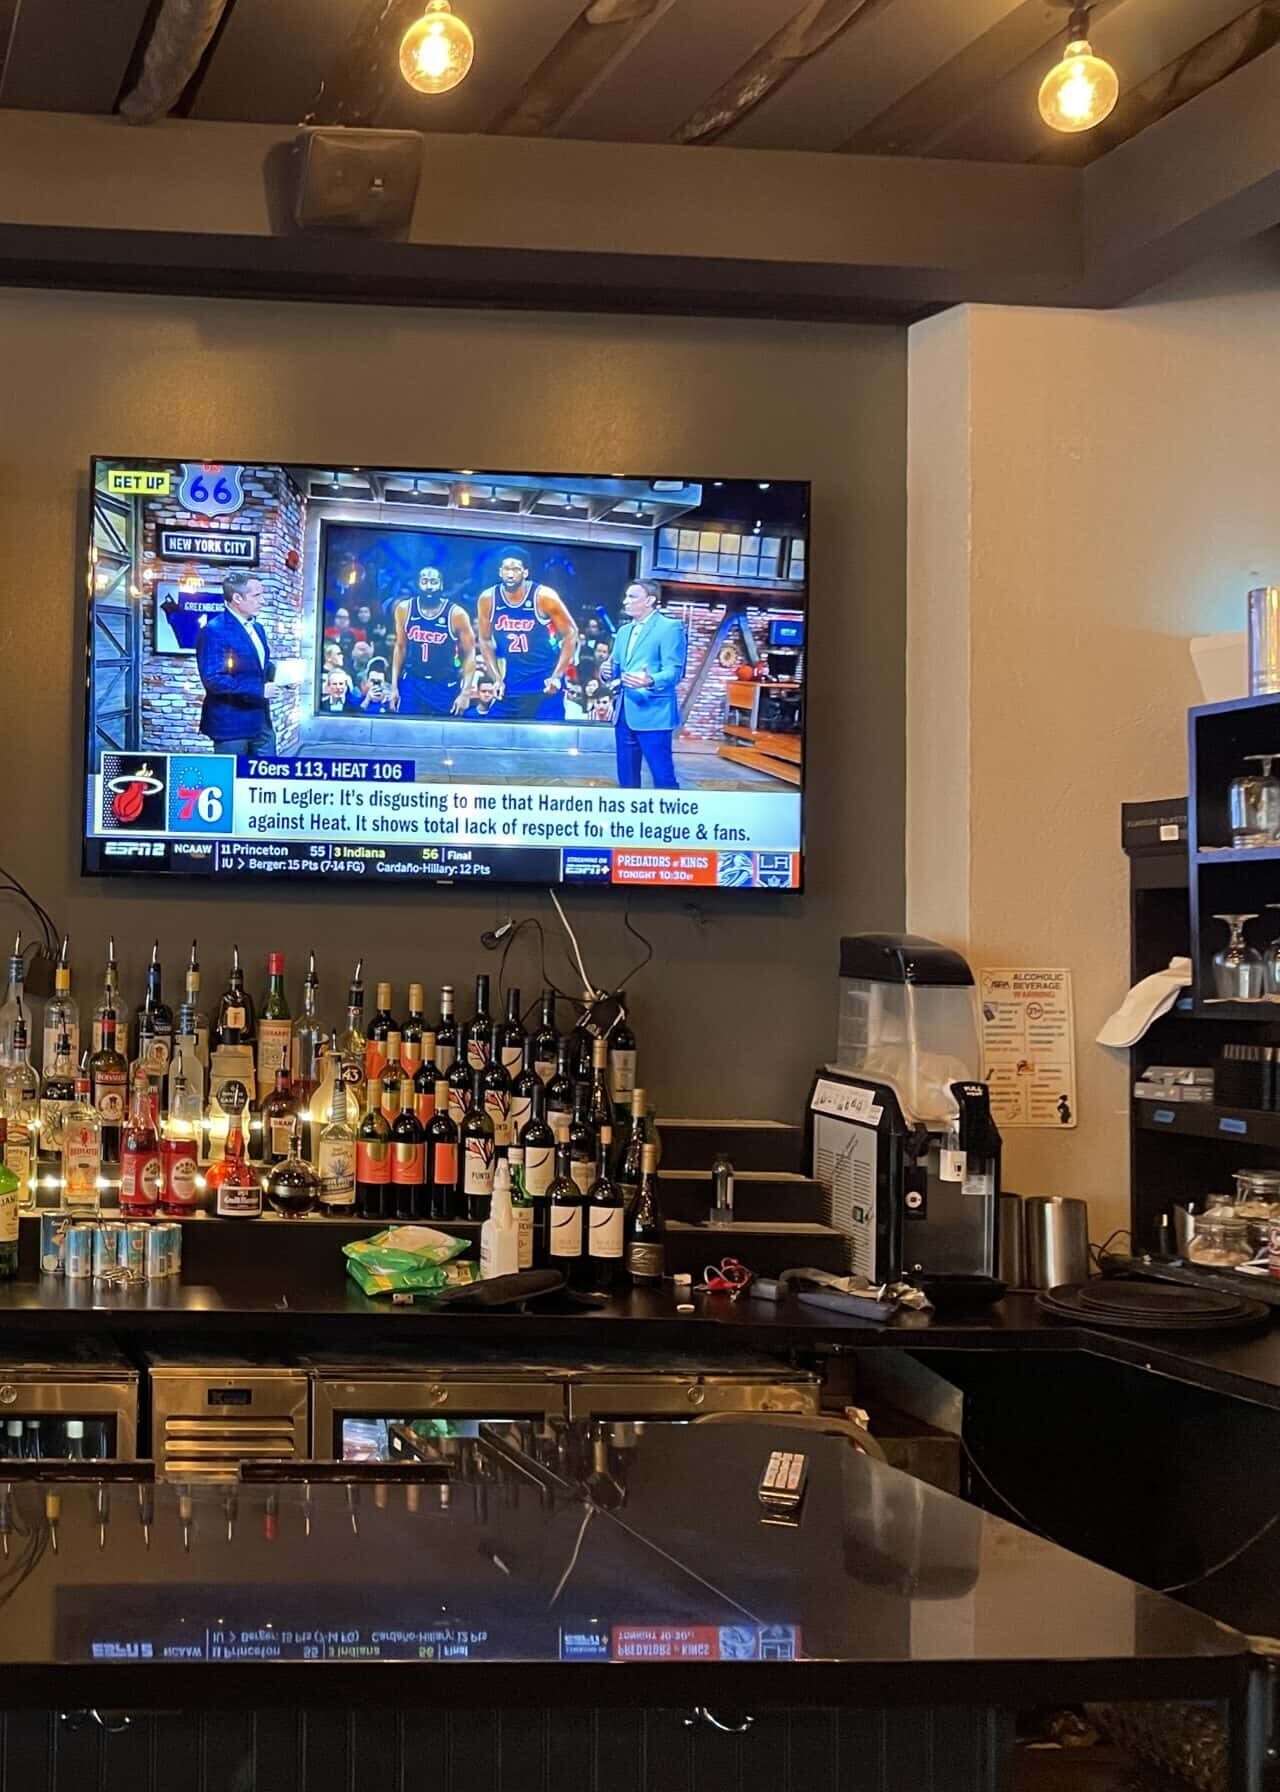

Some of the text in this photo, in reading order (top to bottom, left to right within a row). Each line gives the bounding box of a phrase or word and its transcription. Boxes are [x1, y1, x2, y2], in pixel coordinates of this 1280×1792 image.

[113, 476, 165, 490] GET UP
[190, 475, 232, 504] 66
[169, 538, 248, 555] NEW YORK CITY
[507, 634, 529, 653] 21
[421, 643, 430, 662] 1
[248, 759, 403, 780] 76ers 113, HEAT 106
[178, 786, 224, 823] 76
[249, 787, 699, 815] Tim Legler: It's disgusting to me that Harden has sat twice
[248, 813, 751, 843] against Heat. It shows total lack of respect for the league & fans.
[174, 843, 212, 854] NCAAW
[221, 844, 326, 857] 11 Princeton 55
[334, 847, 439, 860] 3 Indiana 56
[448, 850, 473, 861] Final
[222, 858, 234, 869] IU
[249, 859, 287, 872] Berger:
[288, 860, 300, 870] 15
[301, 860, 318, 870] Pts
[347, 861, 366, 874] FG)
[460, 865, 471, 875] 12
[473, 865, 491, 875] Pts
[617, 855, 671, 867] PREDATORS
[680, 857, 709, 869] KINGS
[761, 855, 790, 870] LA
[618, 870, 657, 879] TONIGHT
[1012, 973, 1065, 981] ALCOHOLIC
[1012, 982, 1062, 990] BEVERAGE
[342, 1069, 360, 1082] 43
